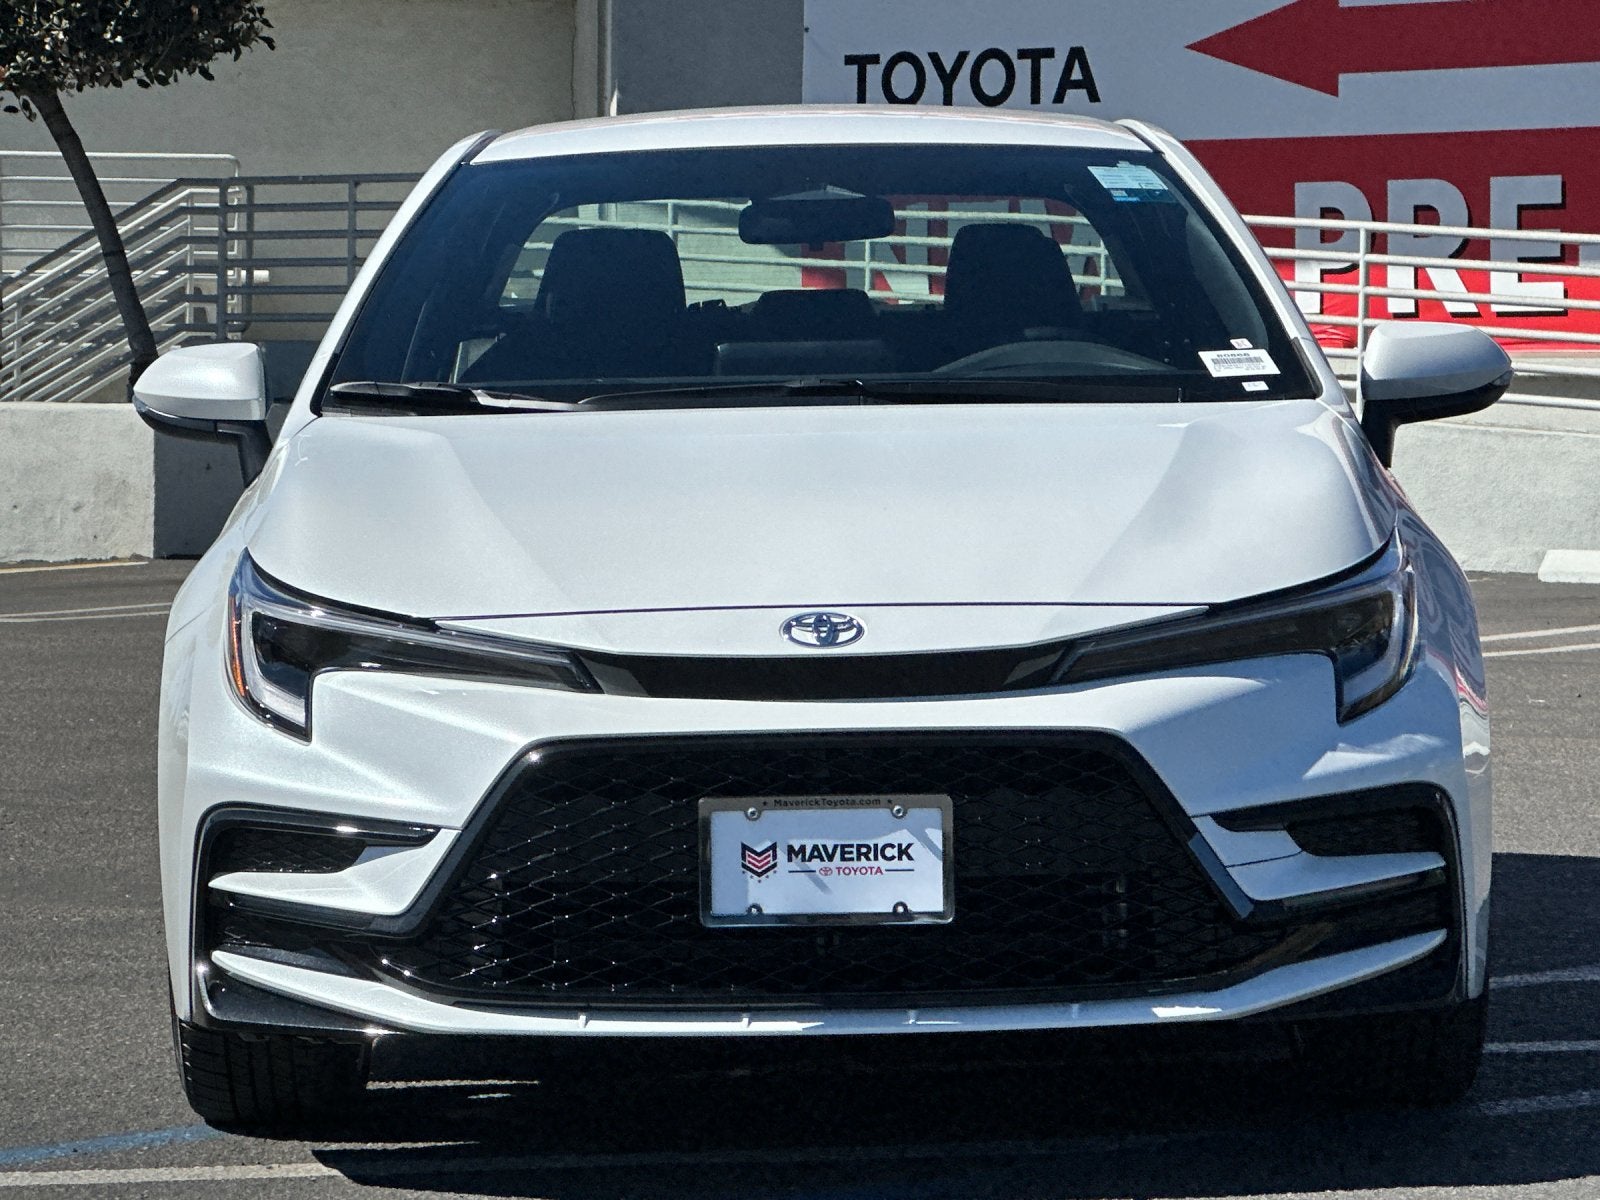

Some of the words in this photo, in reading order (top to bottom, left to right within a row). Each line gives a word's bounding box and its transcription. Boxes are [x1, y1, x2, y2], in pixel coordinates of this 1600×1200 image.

[844, 46, 1101, 107] TOYOTA
[774, 798, 881, 808] MaverickToyota.com
[787, 843, 914, 863] MAVERICK
[836, 866, 883, 876] TOYOTA
